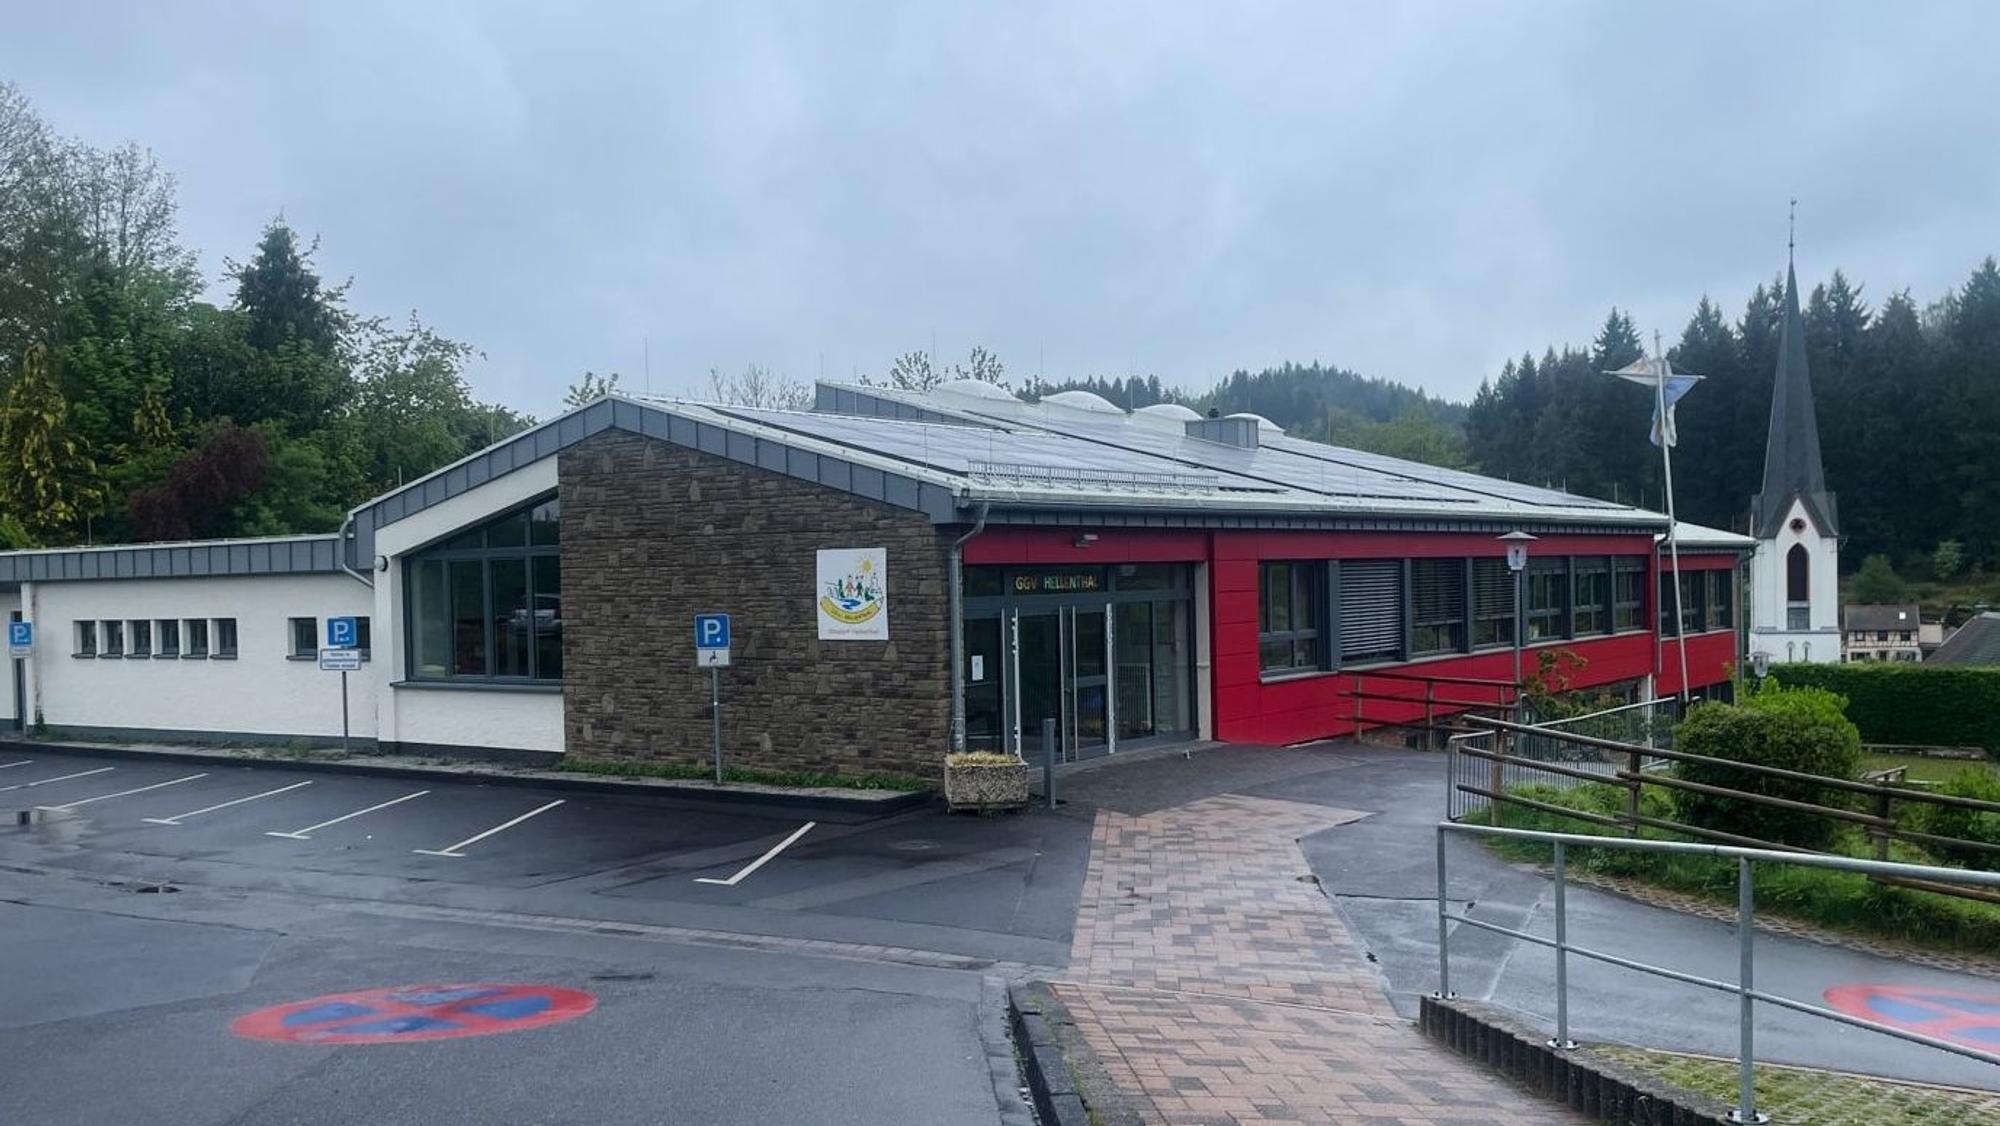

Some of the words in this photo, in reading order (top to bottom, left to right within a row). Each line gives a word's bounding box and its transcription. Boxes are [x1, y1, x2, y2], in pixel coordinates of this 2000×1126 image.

[14, 625, 27, 643] P
[334, 621, 348, 643] P
[704, 619, 720, 644] P
